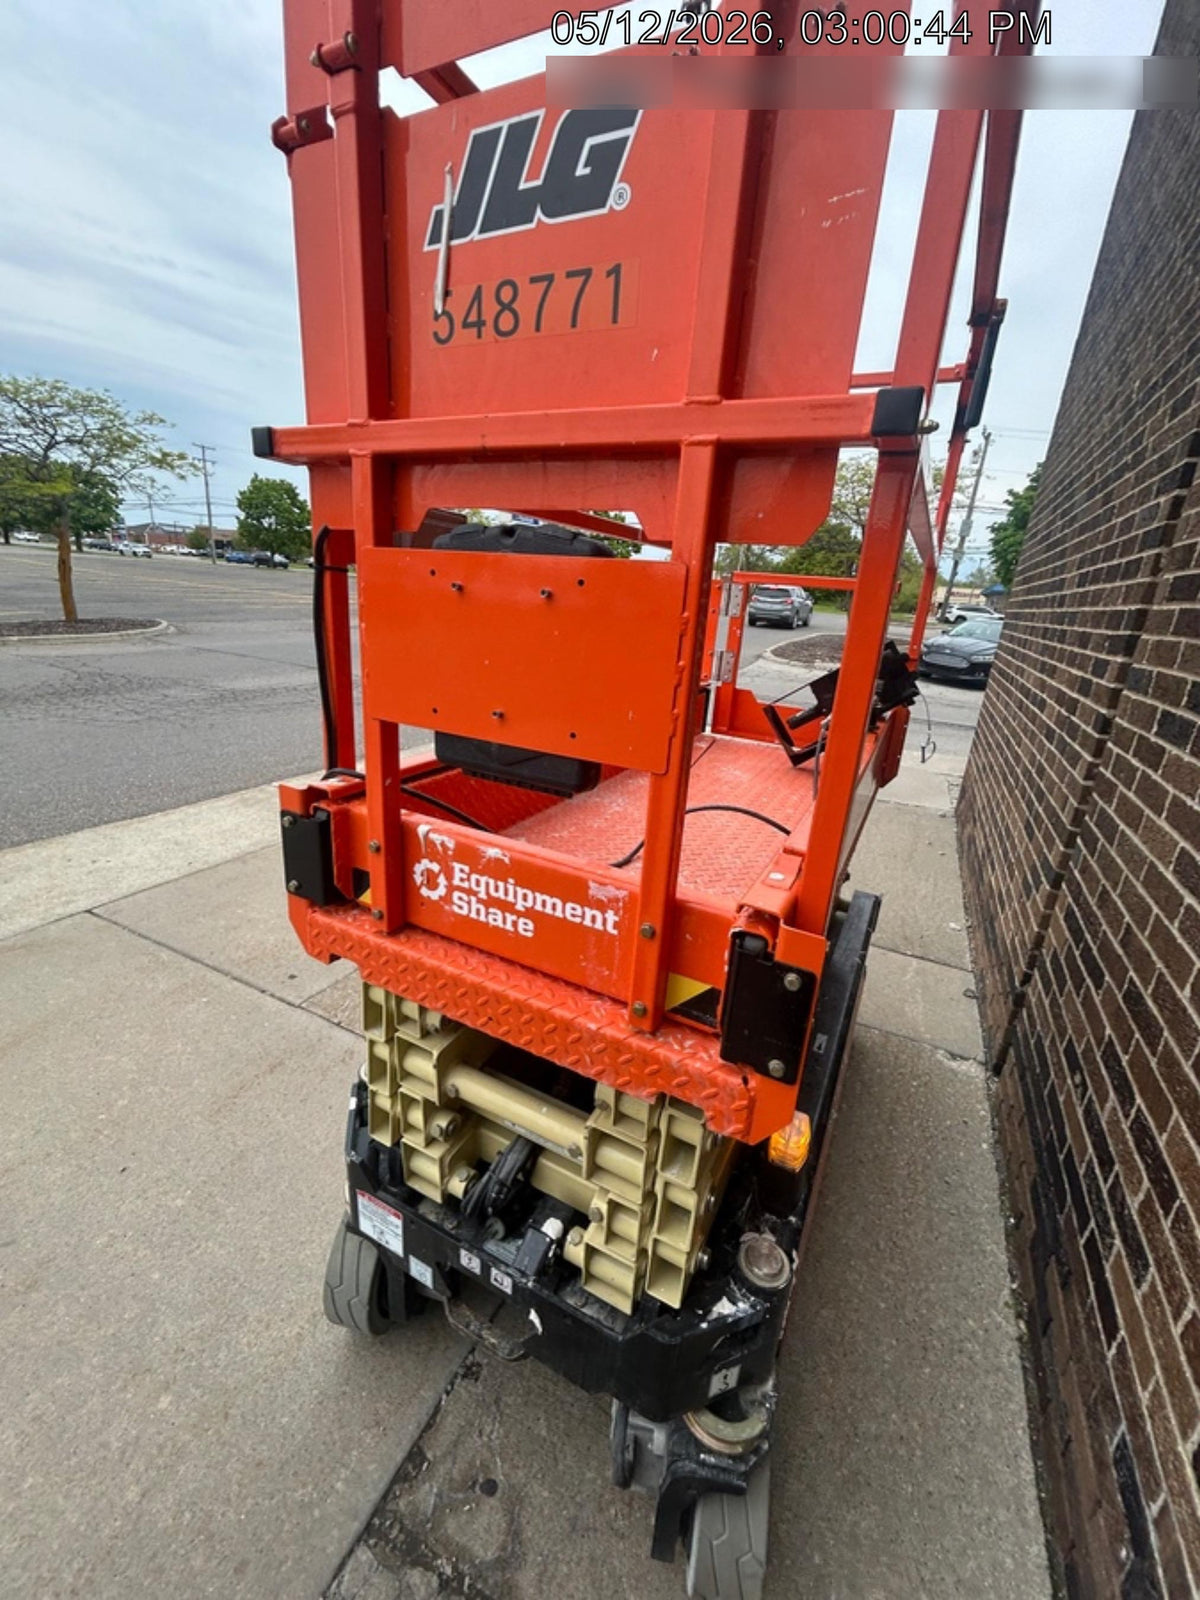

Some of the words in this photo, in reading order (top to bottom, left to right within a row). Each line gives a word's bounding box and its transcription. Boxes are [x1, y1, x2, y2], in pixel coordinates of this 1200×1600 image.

[432, 262, 623, 345] 548771
[451, 861, 620, 935] Equipment
[451, 890, 535, 938] Share
